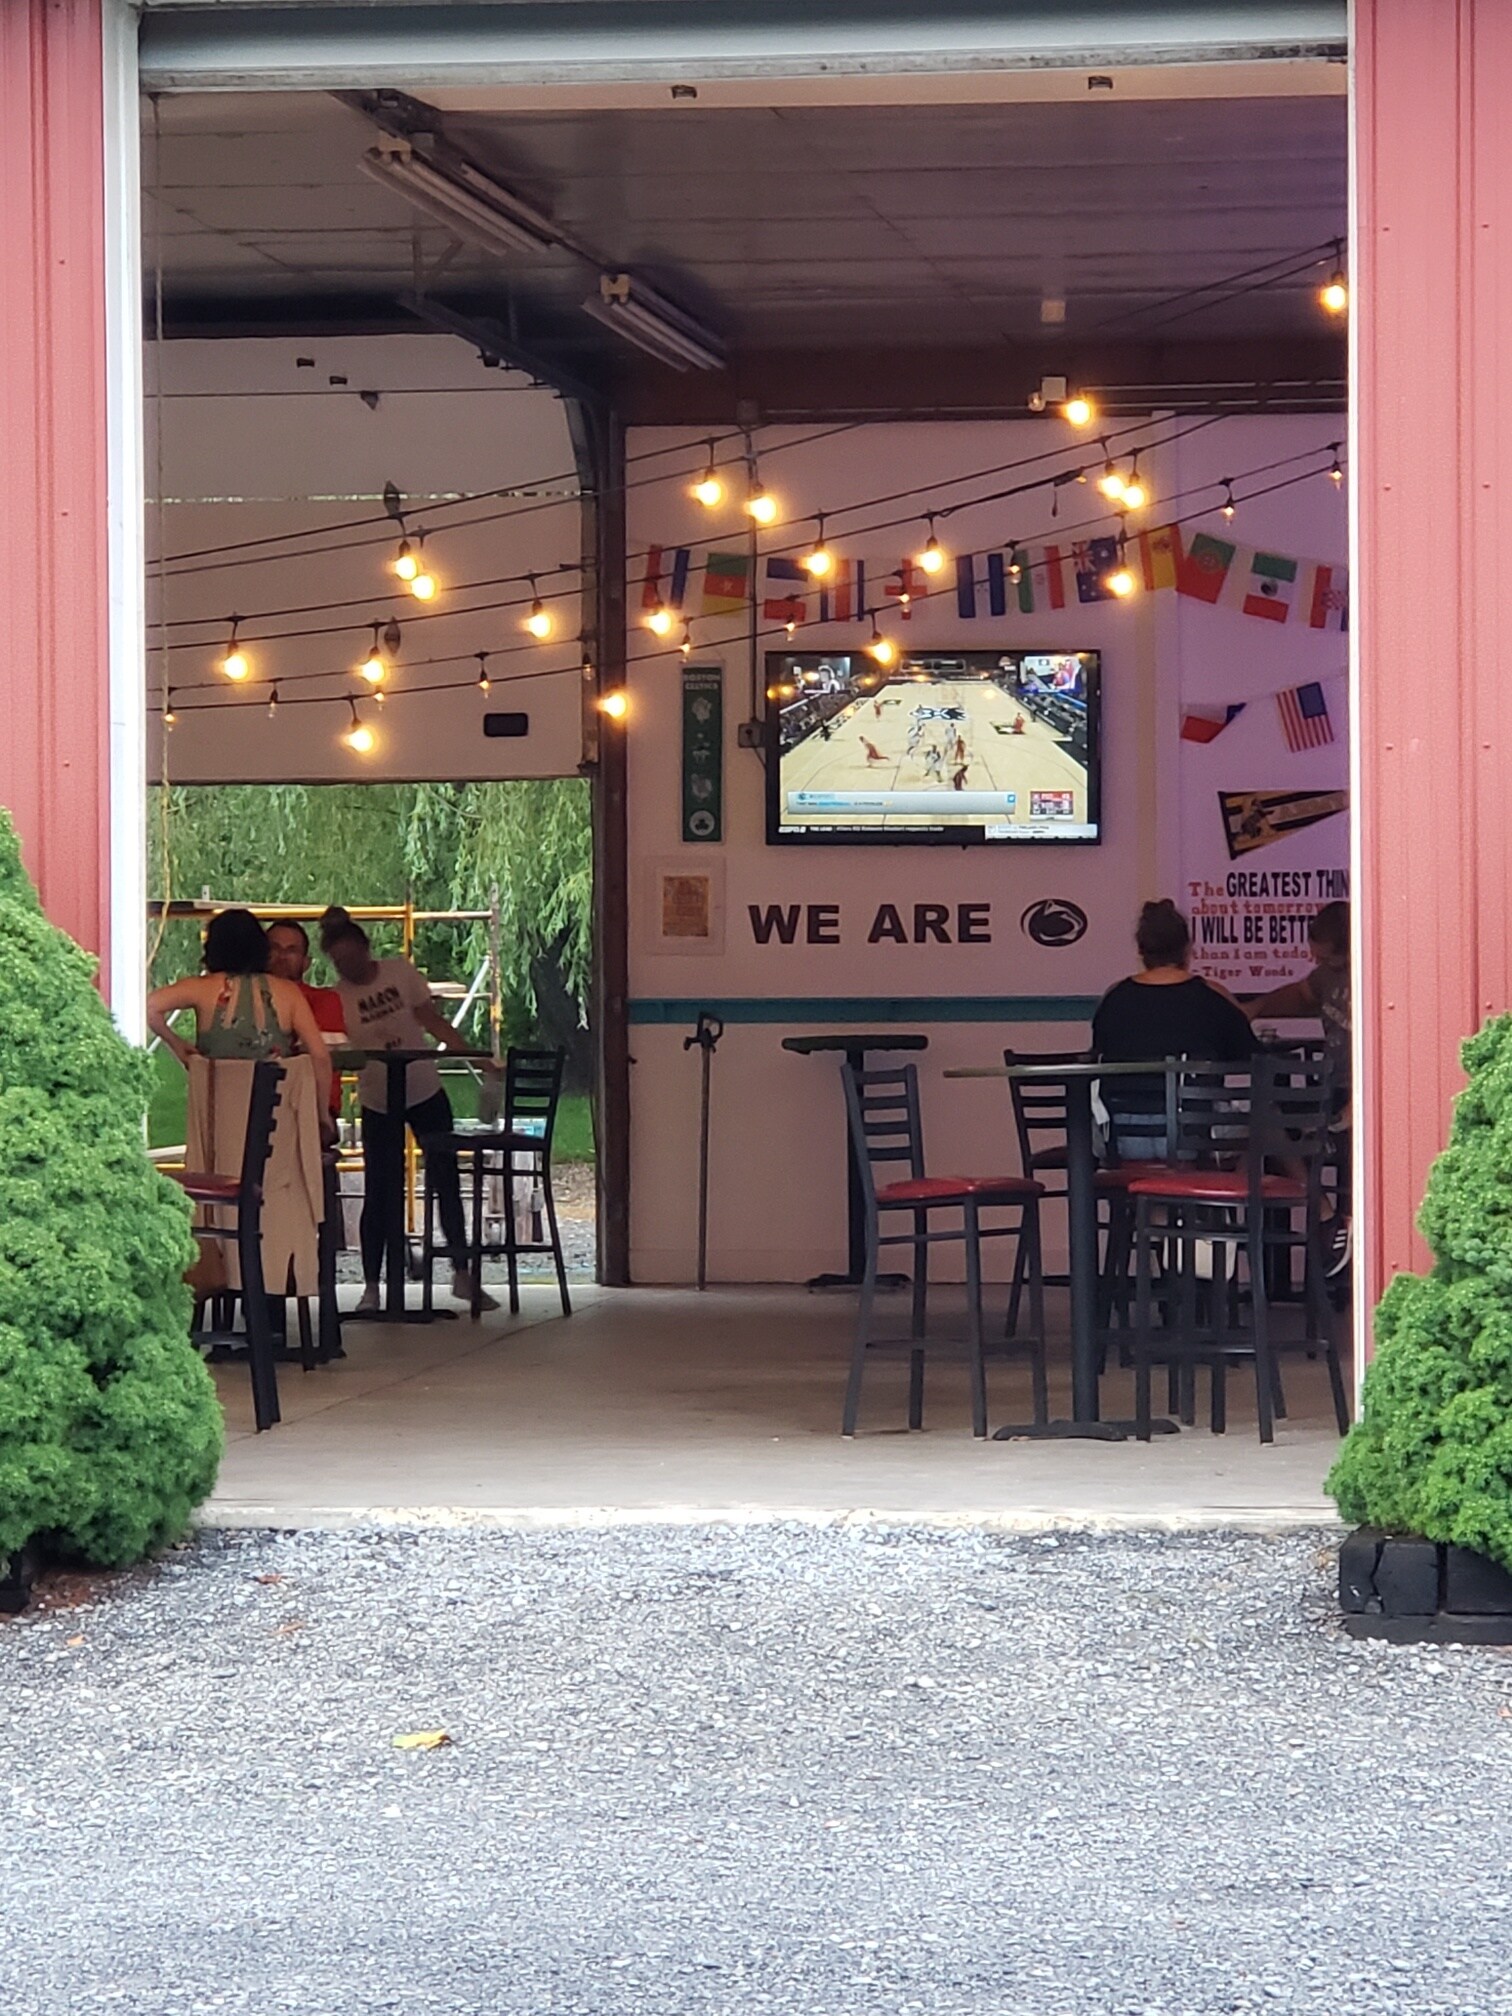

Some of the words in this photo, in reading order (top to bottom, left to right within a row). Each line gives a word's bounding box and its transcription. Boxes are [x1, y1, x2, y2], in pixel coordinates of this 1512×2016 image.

[1188, 881, 1225, 897] The
[1226, 871, 1312, 898] GREATEST
[1191, 897, 1238, 915] about
[748, 903, 841, 945] WE
[867, 902, 992, 944] ARE
[1192, 915, 1196, 943] I
[1201, 915, 1239, 944] WILL
[1243, 915, 1264, 944] BE
[1191, 946, 1230, 960] than
[1233, 947, 1241, 960] I
[1243, 951, 1268, 960] am
[1248, 965, 1294, 977] Woods
